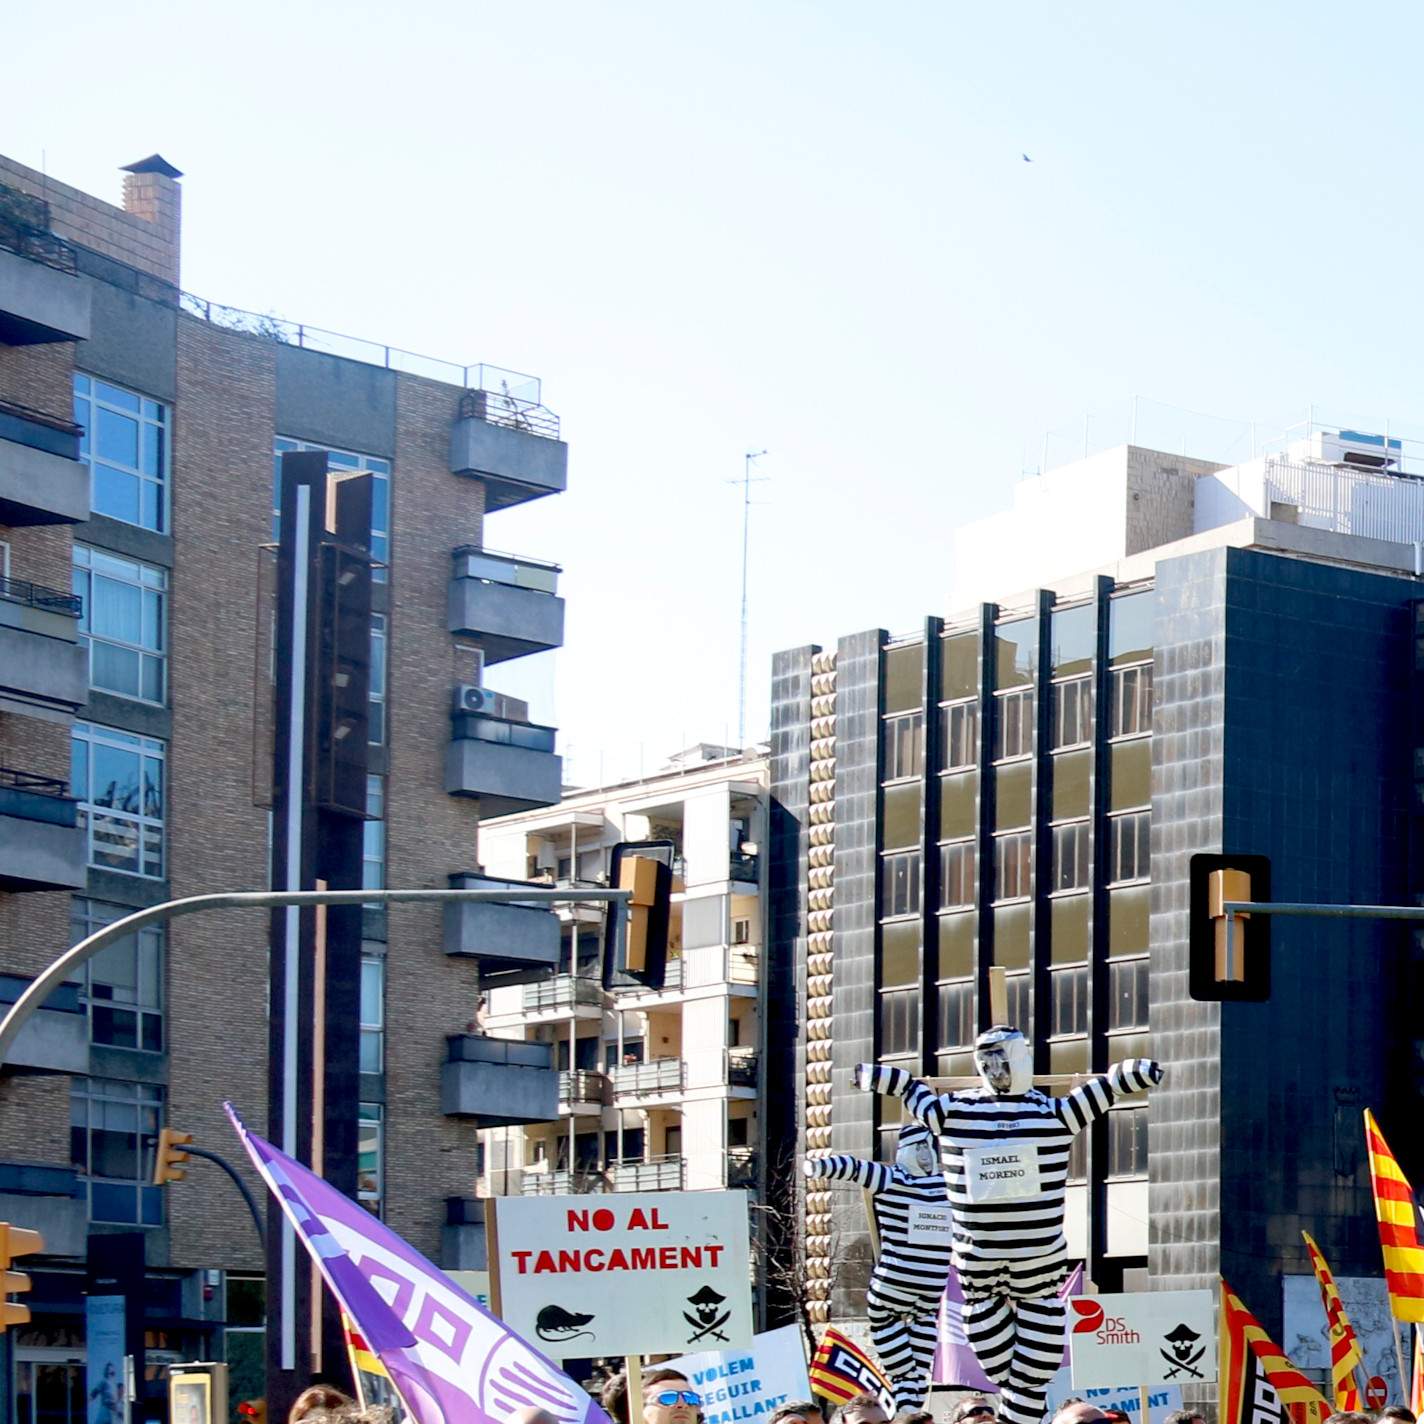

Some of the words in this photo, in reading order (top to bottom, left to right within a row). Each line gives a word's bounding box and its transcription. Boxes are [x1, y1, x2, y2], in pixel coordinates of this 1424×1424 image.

[981, 1155, 1021, 1166] ISMAEL
[979, 1169, 1025, 1181] MORENO
[567, 1208, 615, 1232] NO
[627, 1207, 669, 1230] AL
[511, 1245, 724, 1274] TANCAMENT
[1106, 1317, 1126, 1332] DS
[1097, 1330, 1140, 1345] Smith
[692, 1357, 755, 1386] VOLEM
